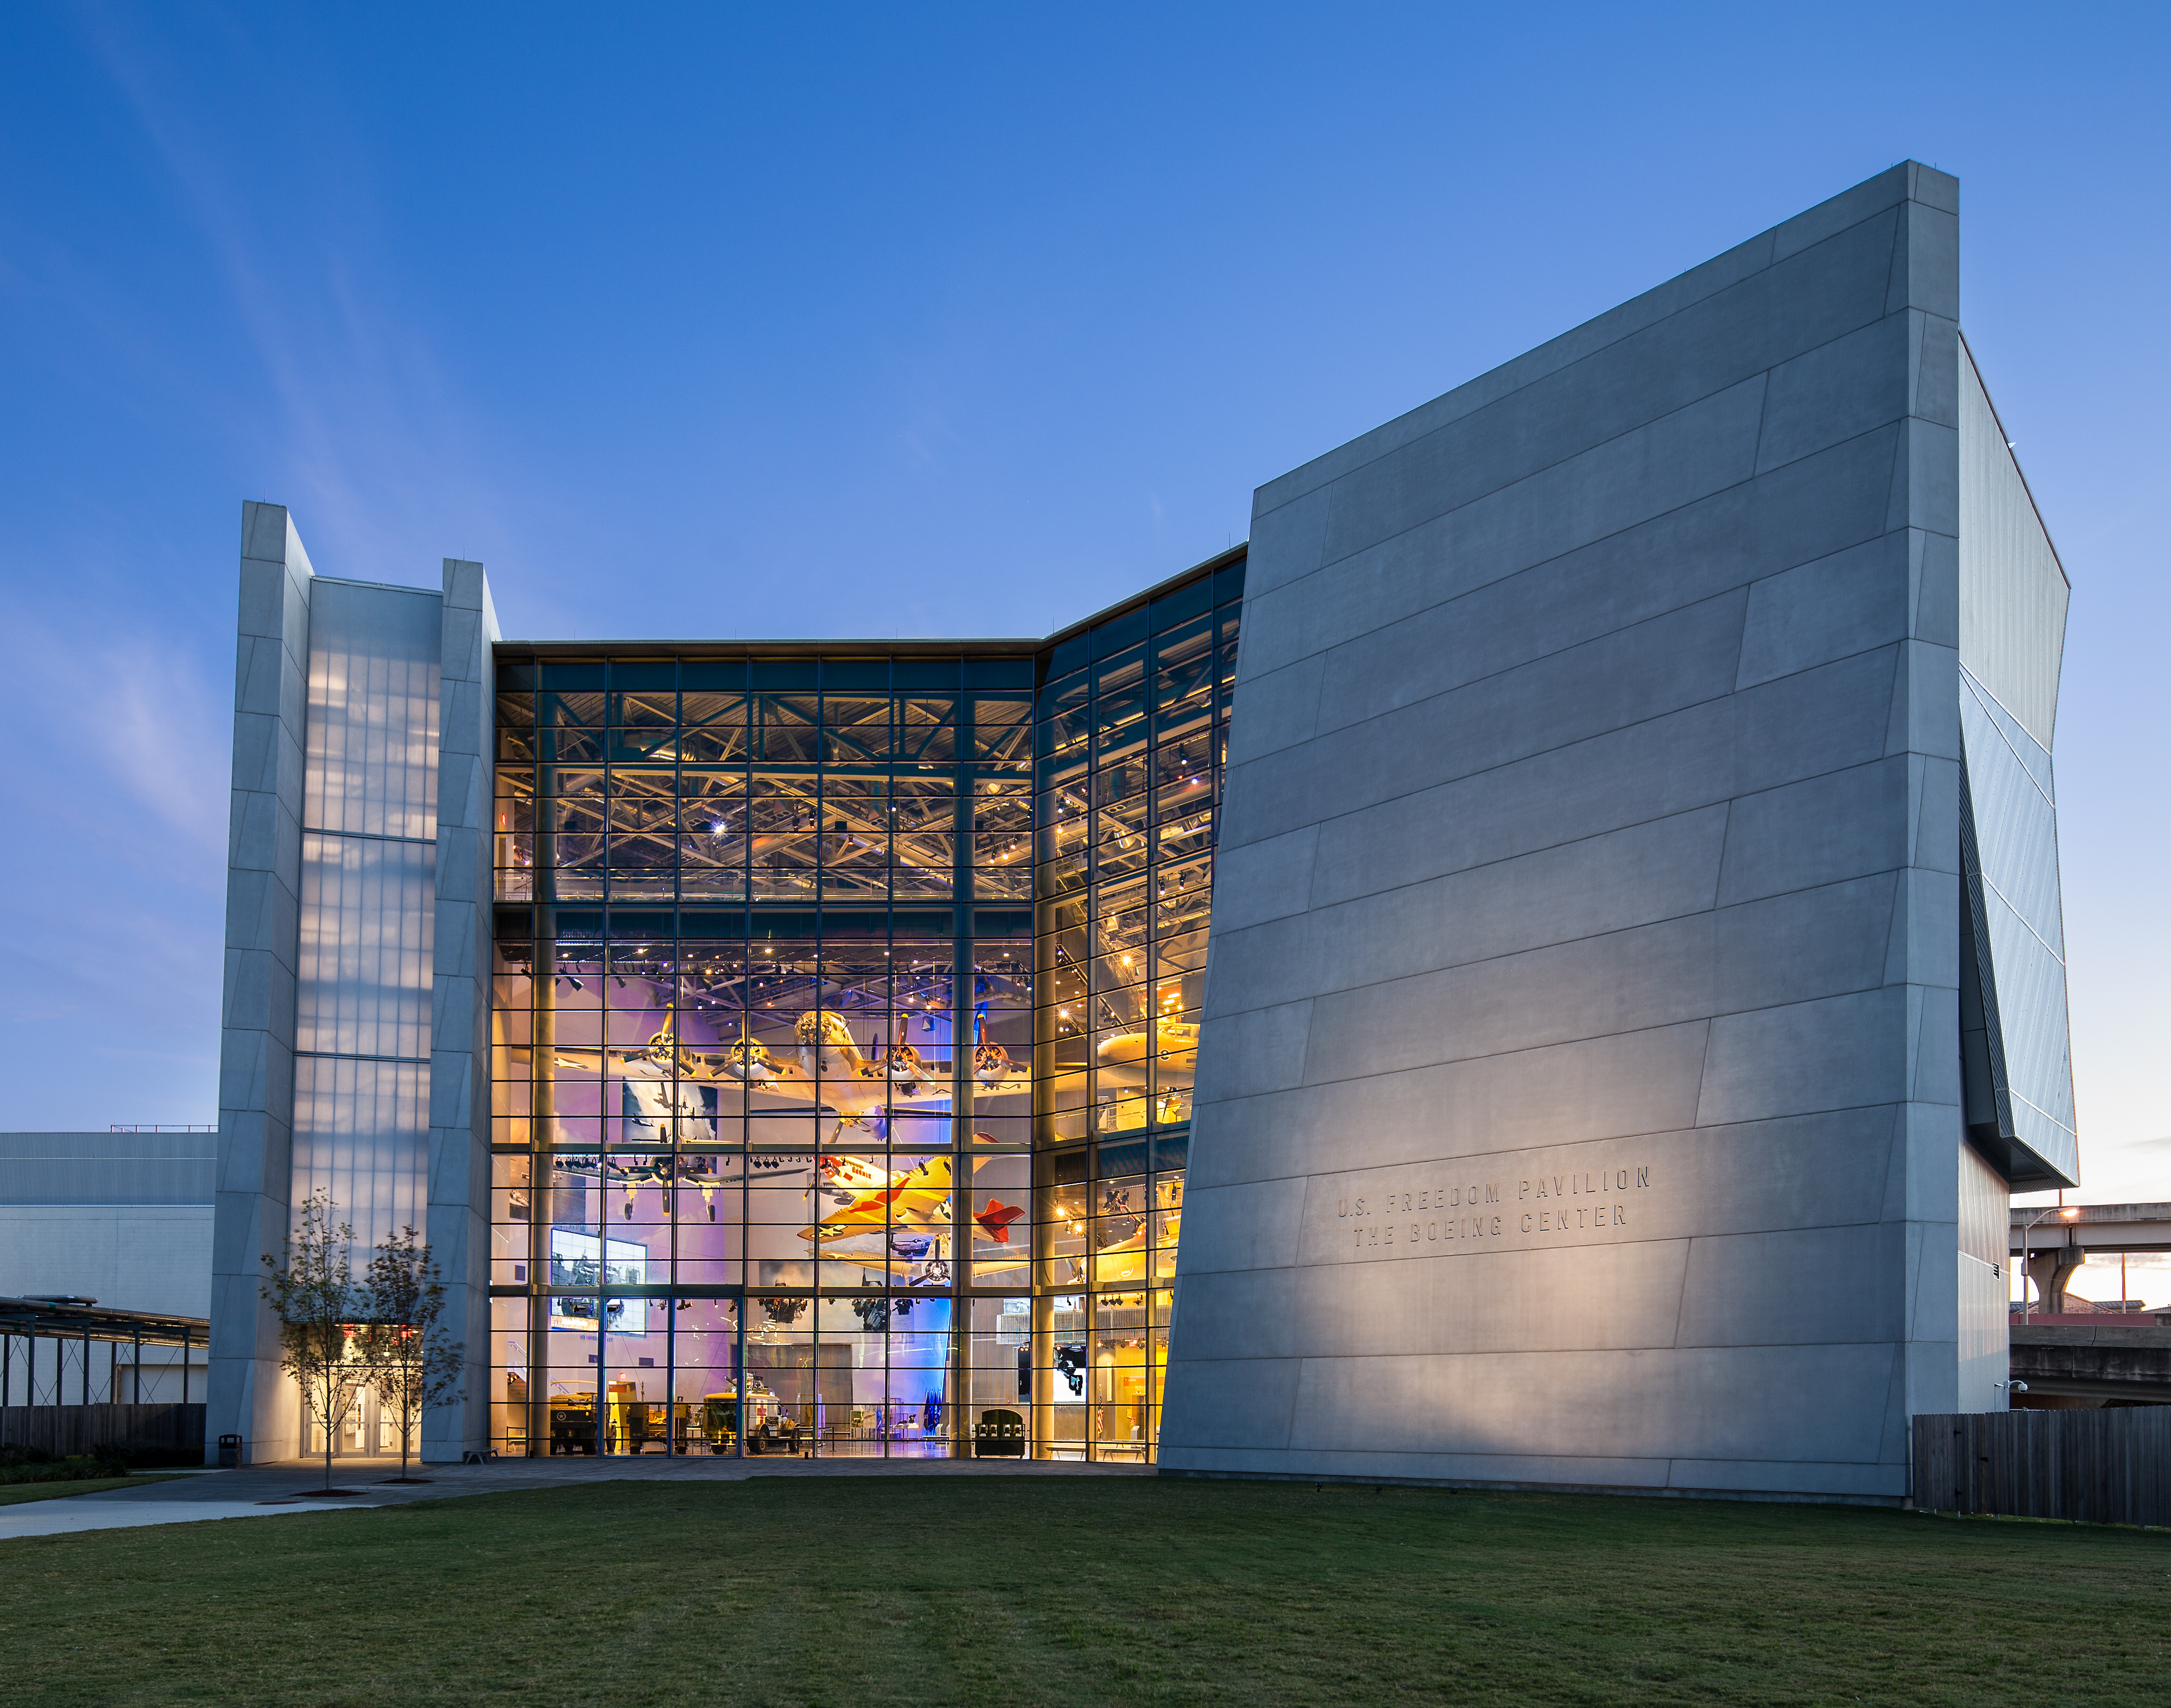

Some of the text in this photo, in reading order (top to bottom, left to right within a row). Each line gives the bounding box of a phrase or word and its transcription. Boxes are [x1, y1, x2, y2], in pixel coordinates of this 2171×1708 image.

[1337, 1165, 1650, 1218] U.S. FREEDOM PAVILION
[1354, 1203, 1627, 1247] THE BOEING CENTER
